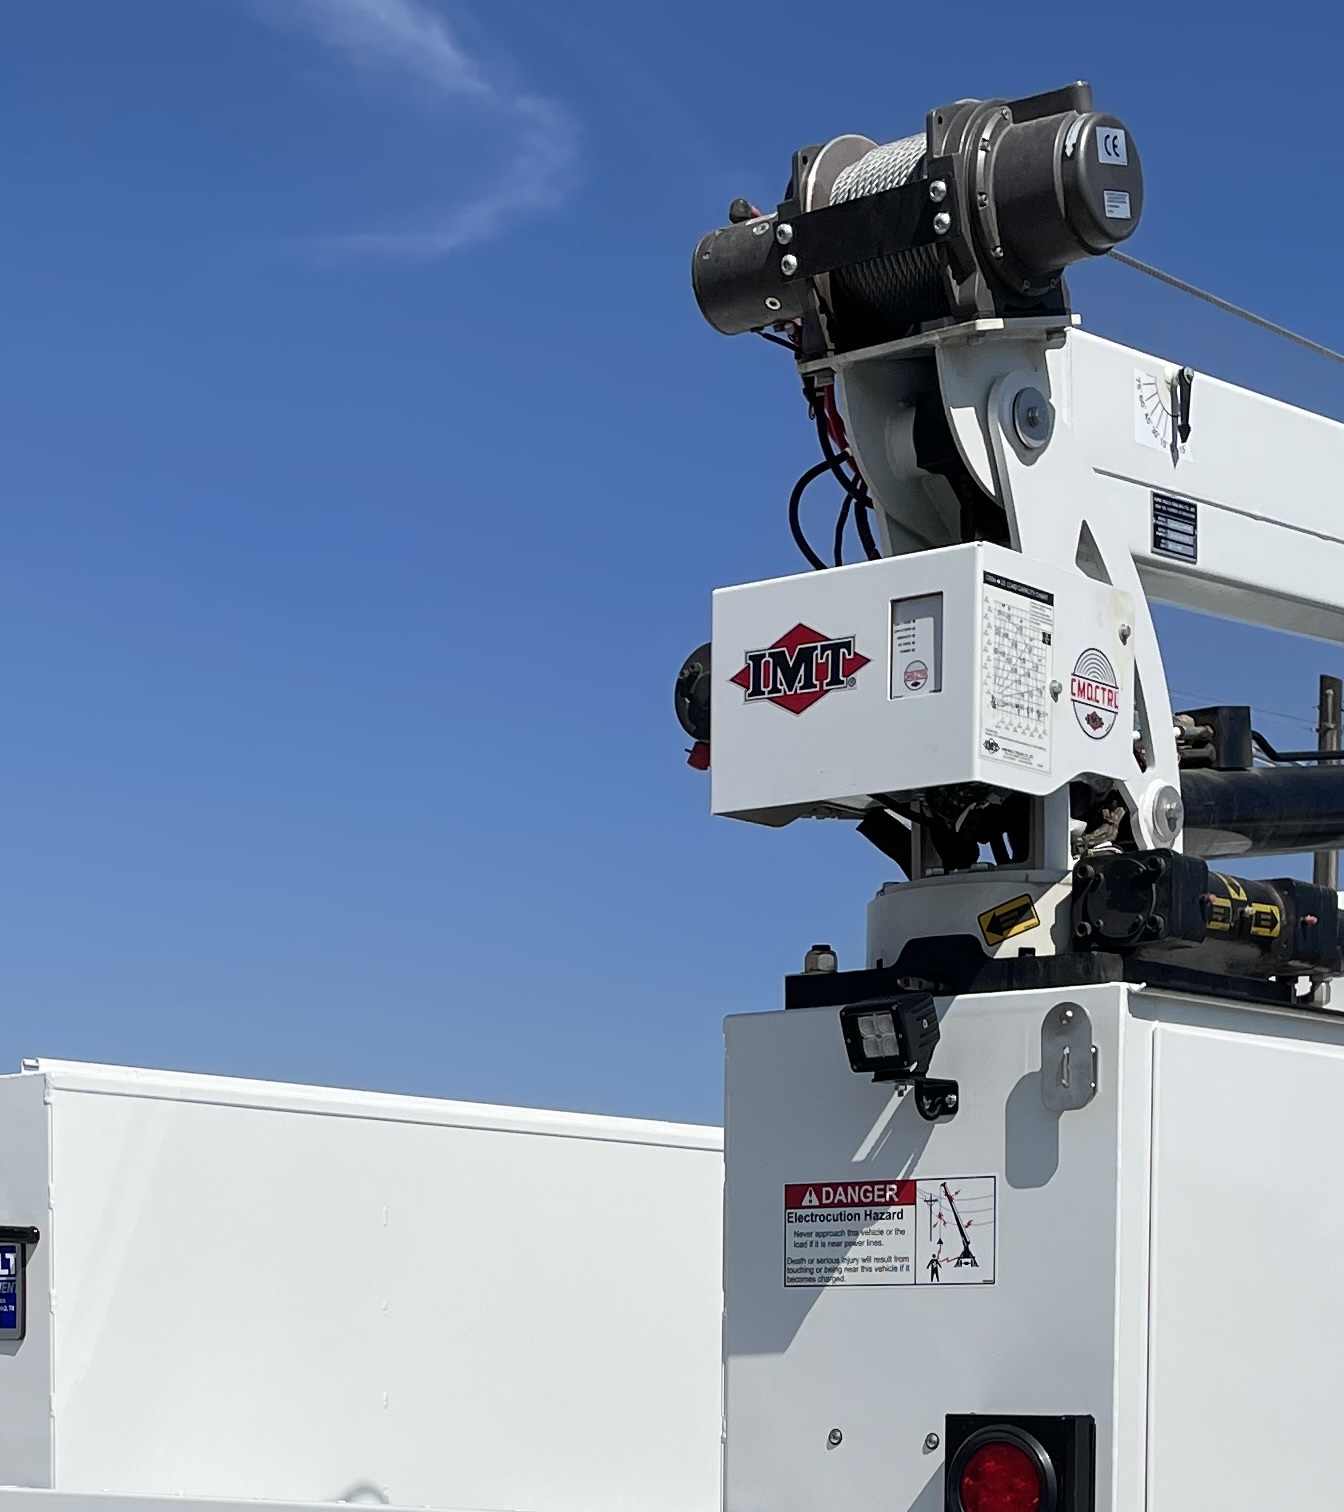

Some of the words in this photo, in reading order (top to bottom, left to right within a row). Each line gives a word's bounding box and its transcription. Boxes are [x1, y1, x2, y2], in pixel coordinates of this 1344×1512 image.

[746, 637, 855, 700] IMT
[822, 1184, 899, 1204] DANGER
[787, 1210, 861, 1223] Electrocution
[864, 1208, 904, 1222] Hazard
